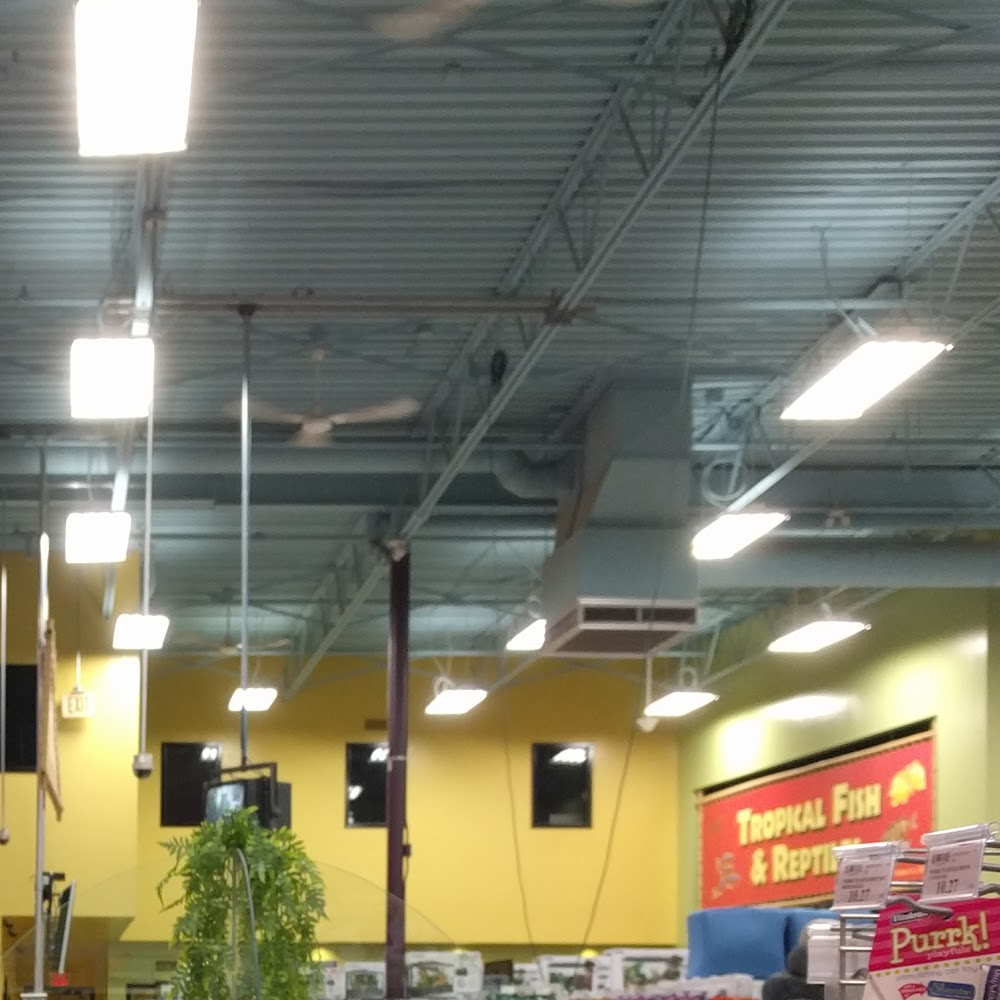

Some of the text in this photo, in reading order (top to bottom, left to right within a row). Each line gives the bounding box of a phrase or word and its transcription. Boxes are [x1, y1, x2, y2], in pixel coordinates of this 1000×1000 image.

[736, 782, 881, 846] TROPICAL FISH
[751, 847, 767, 886] &
[890, 910, 990, 964] Purrk!
